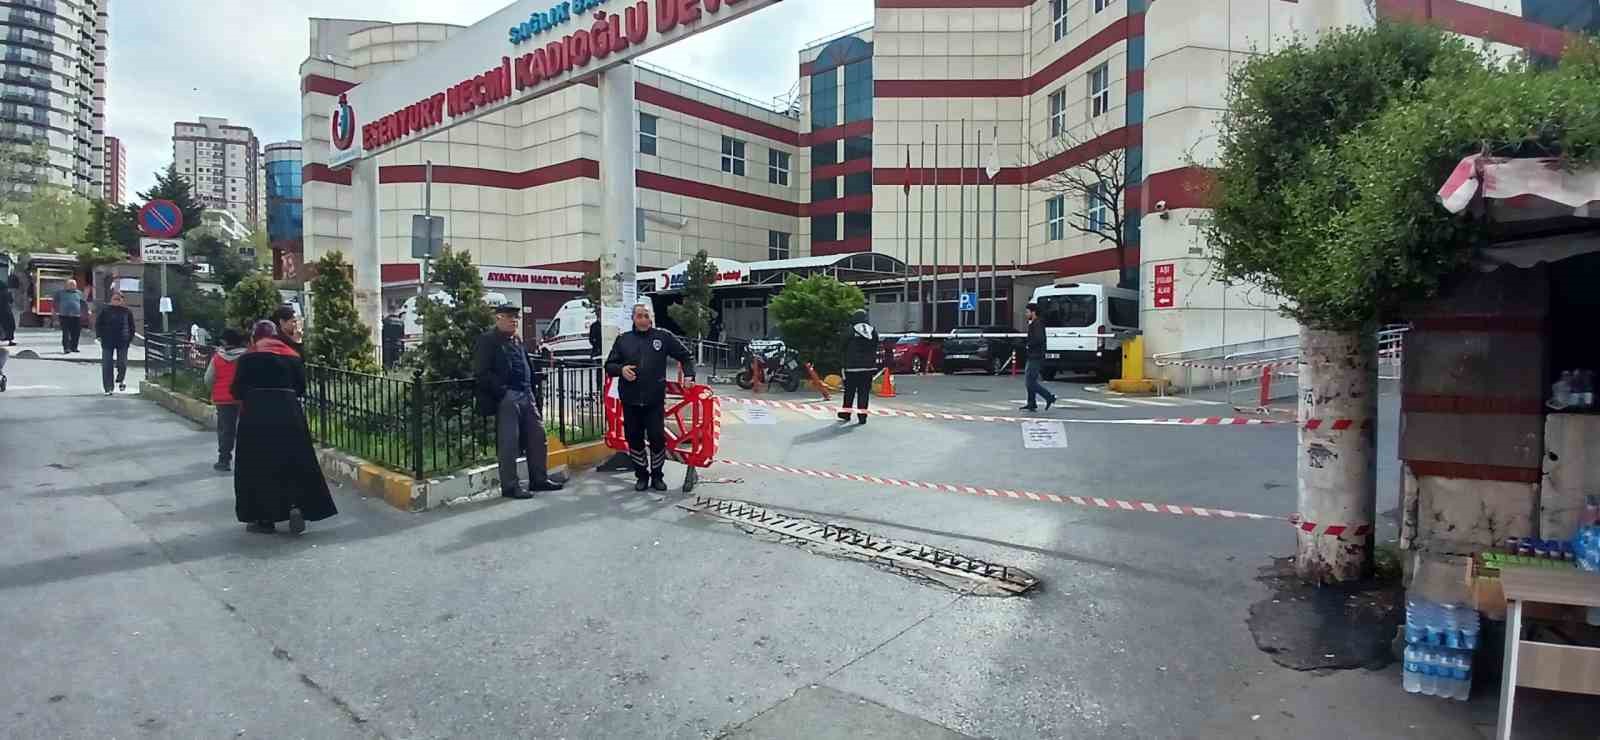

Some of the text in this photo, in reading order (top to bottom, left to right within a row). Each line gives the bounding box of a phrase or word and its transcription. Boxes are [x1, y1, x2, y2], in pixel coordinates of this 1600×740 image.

[508, 1, 570, 45] SAĞLIK
[361, 92, 446, 151] ESENYURT
[447, 55, 512, 118] NECMİ
[515, 1, 648, 91] KADIOĞLU
[487, 272, 529, 283] AYAKTAN
[530, 274, 559, 285] HASTA
[960, 294, 970, 309] P
